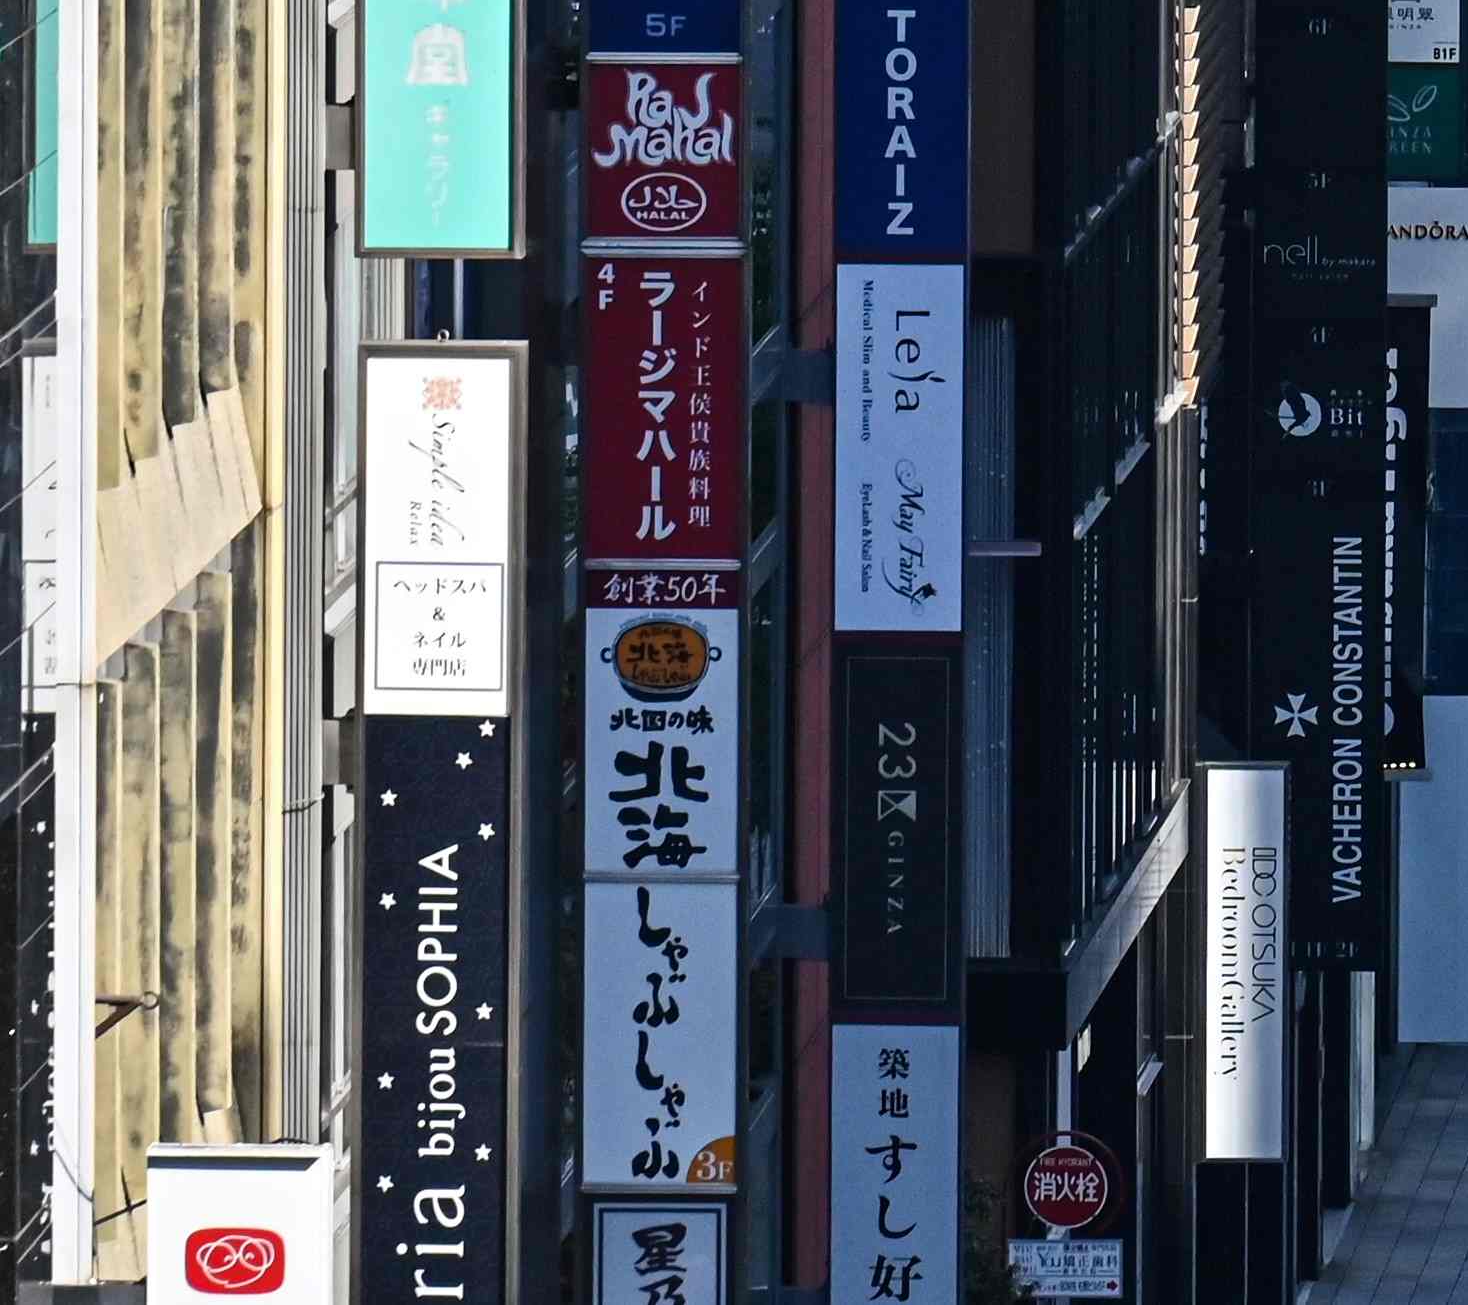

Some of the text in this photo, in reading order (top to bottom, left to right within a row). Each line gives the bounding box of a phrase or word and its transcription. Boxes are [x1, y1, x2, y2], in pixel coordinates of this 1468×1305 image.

[646, 14, 687, 38] 5F
[1432, 47, 1457, 60] B1F
[884, 8, 919, 236] TORAIZ
[636, 211, 691, 221] HALAL
[636, 271, 677, 541] ラージマハール
[688, 280, 712, 529] インド王侯貴族料理
[1330, 409, 1363, 427] Bit
[409, 500, 420, 547] Relax
[393, 576, 487, 596] ヘッドスパ
[603, 573, 727, 604] 創業50年
[432, 607, 446, 621] &
[412, 632, 467, 649] ネイル
[411, 656, 467, 678] 専門店
[609, 709, 715, 735] 北国の味
[1331, 536, 1364, 904] VACHERON CONSTANTIN
[608, 742, 709, 869] 北海
[887, 832, 905, 936] GINZA
[417, 843, 460, 1037] SOPHIA
[1252, 908, 1277, 1023] OTSUKA
[632, 886, 688, 1180] しゃぶしゃぶ
[418, 1046, 466, 1158] bijou
[696, 1156, 733, 1181] 3F
[864, 1047, 924, 1303] 築地すし好
[1033, 1172, 1100, 1202] 消火栓
